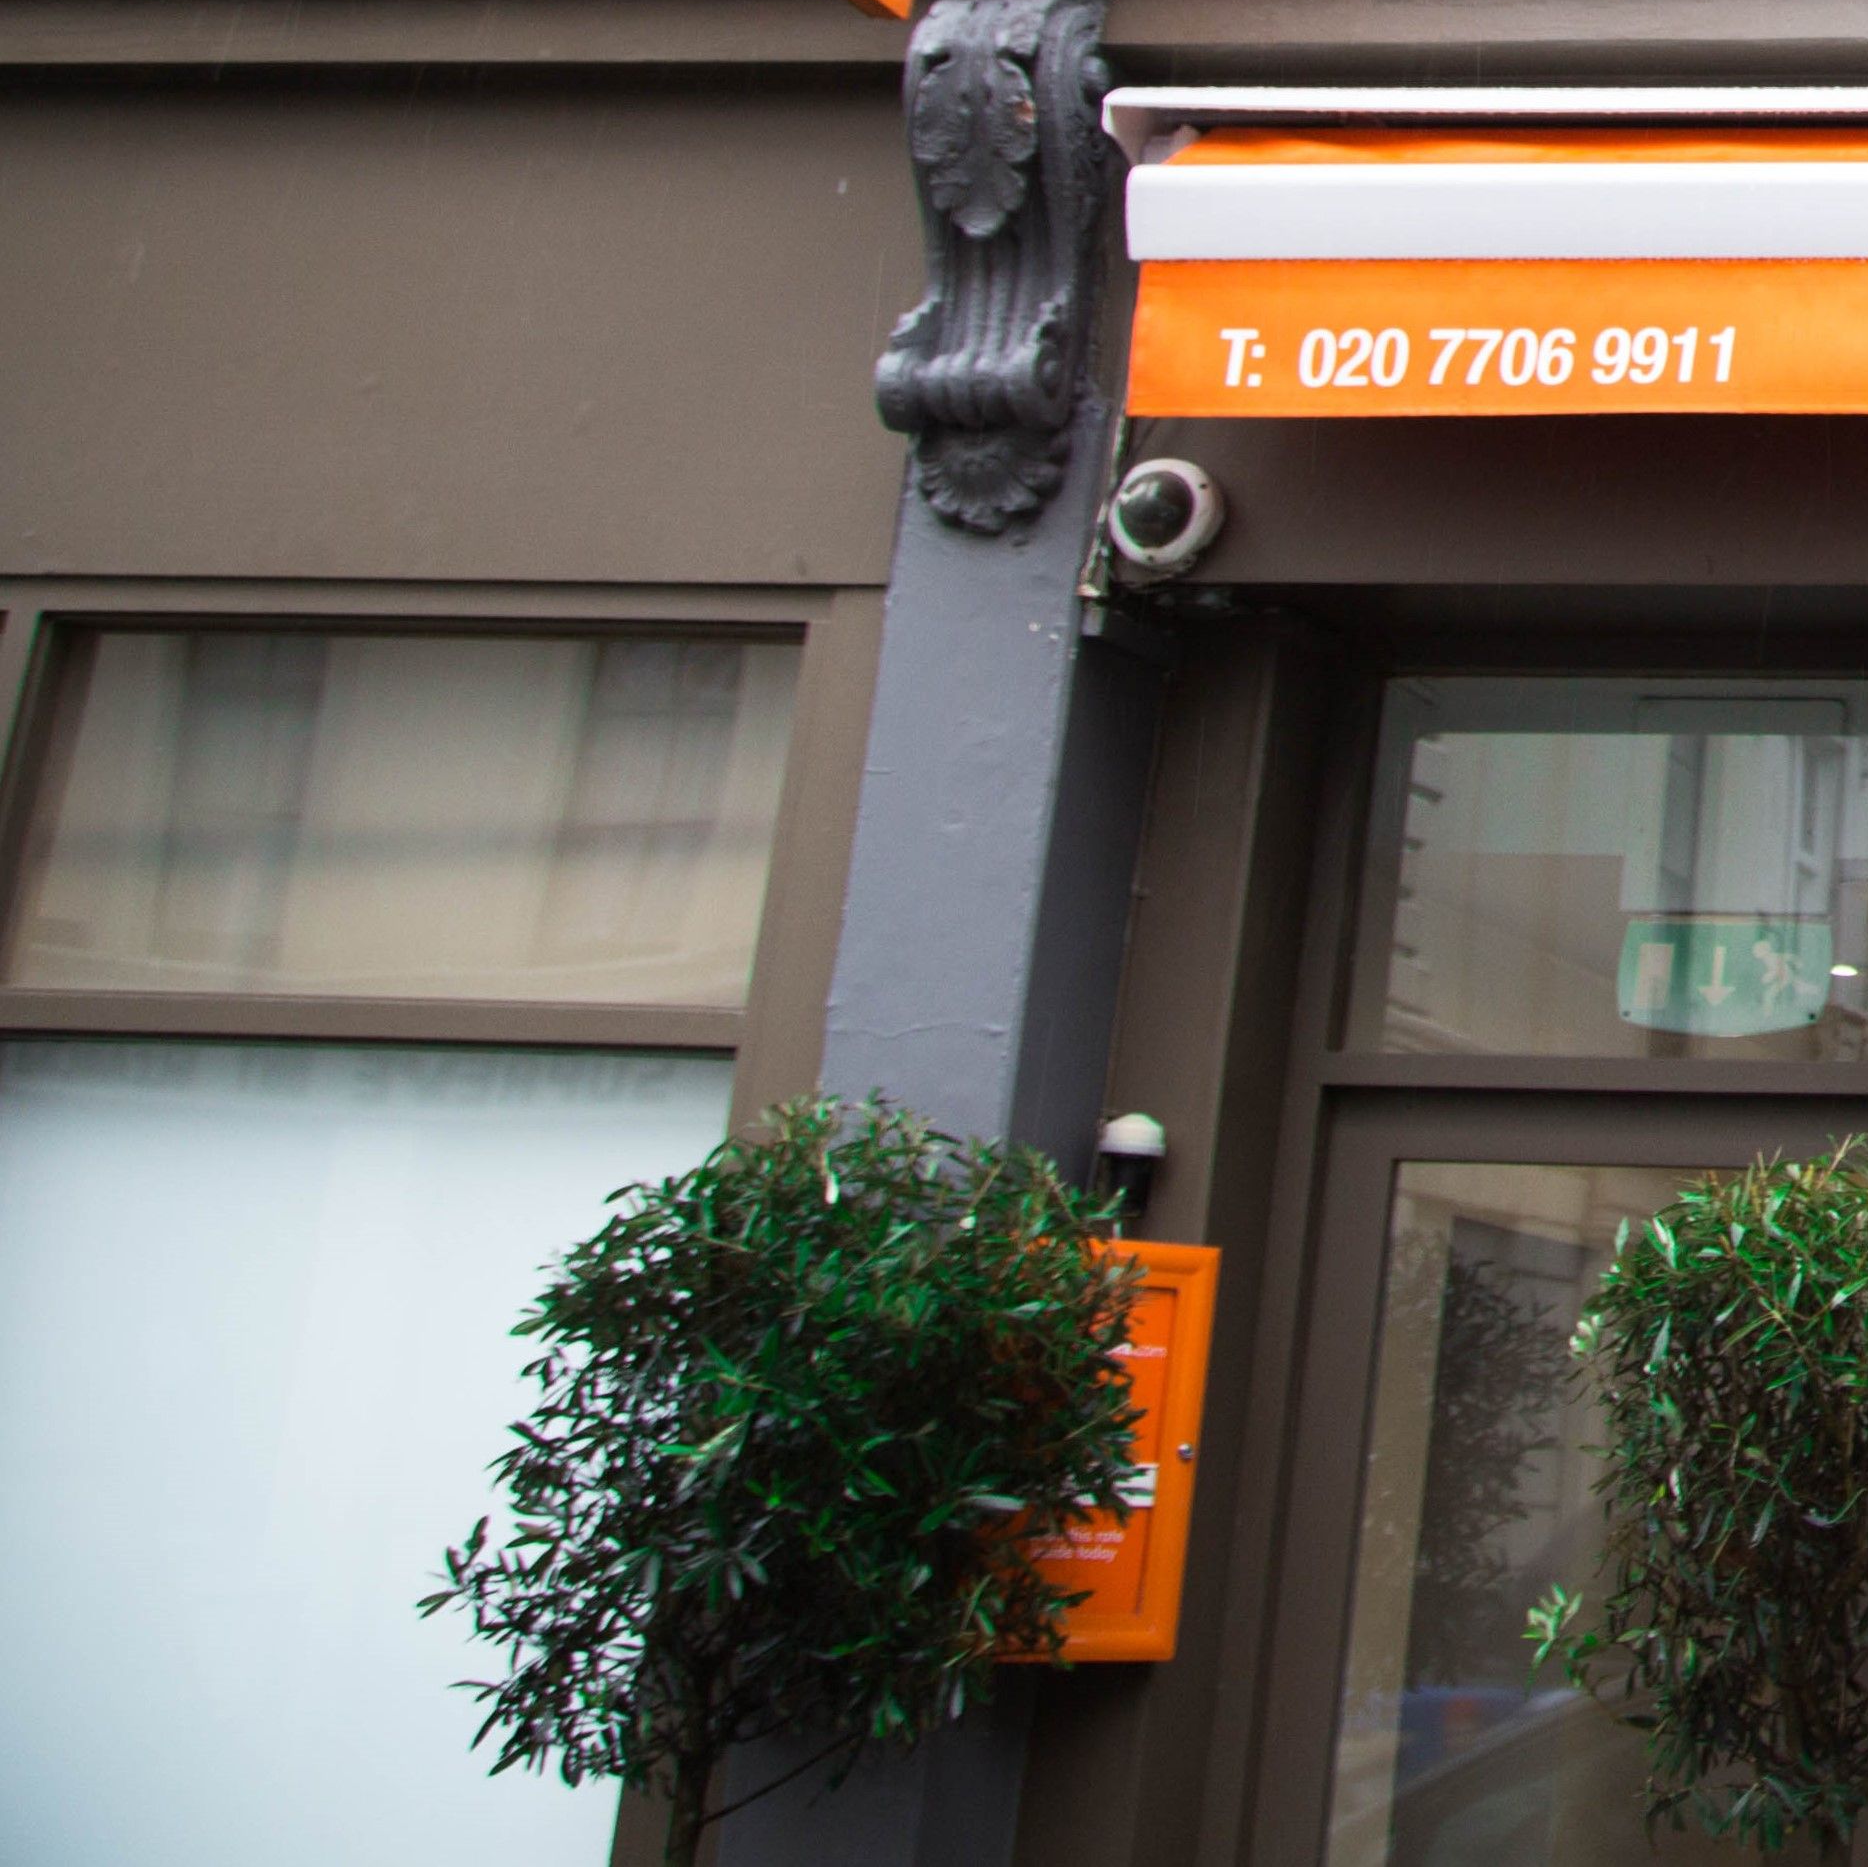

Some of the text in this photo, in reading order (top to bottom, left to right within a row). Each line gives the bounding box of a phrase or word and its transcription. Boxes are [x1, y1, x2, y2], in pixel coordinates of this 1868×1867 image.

[1219, 325, 1736, 388] T: 020 7706 9911
